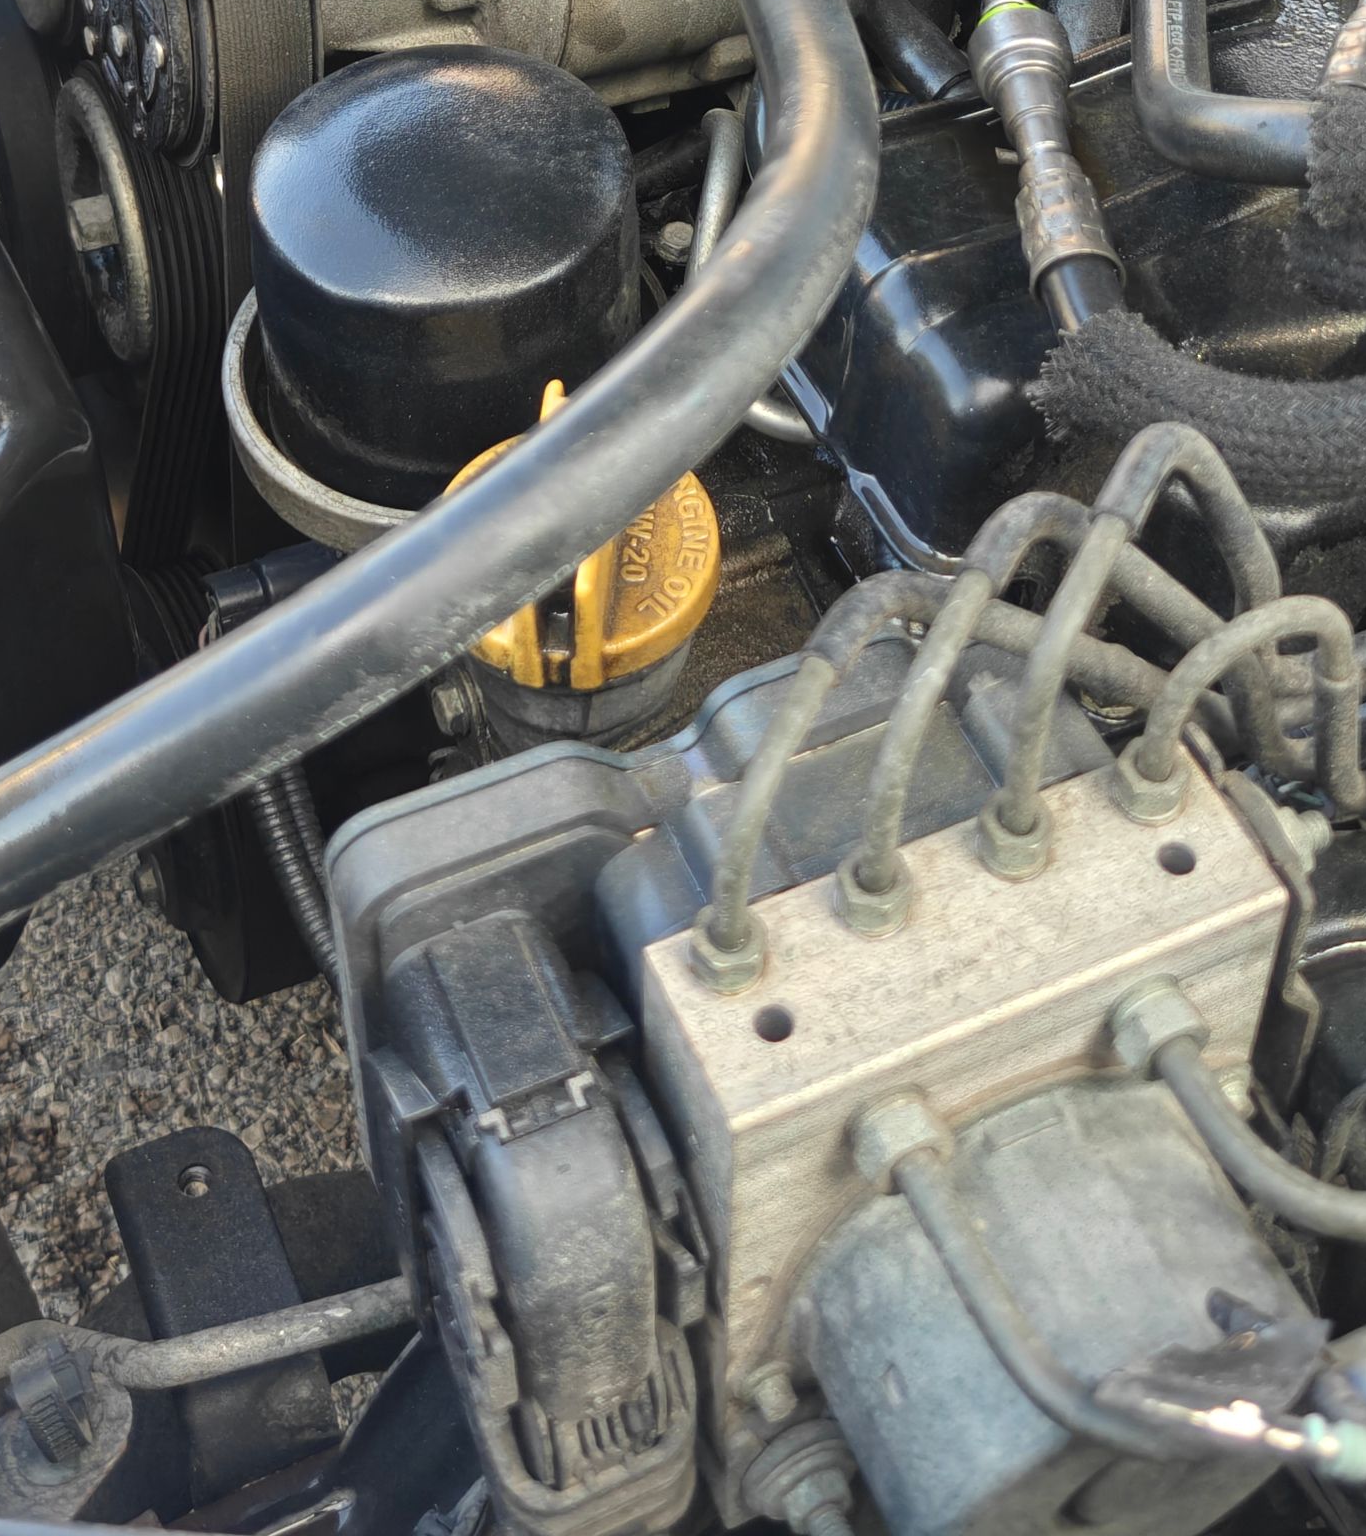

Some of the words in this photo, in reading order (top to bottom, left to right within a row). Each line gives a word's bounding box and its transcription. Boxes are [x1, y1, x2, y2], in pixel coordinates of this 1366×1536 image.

[620, 503, 656, 583] W-20
[673, 476, 711, 571] NGINE
[636, 575, 693, 618] OIL
